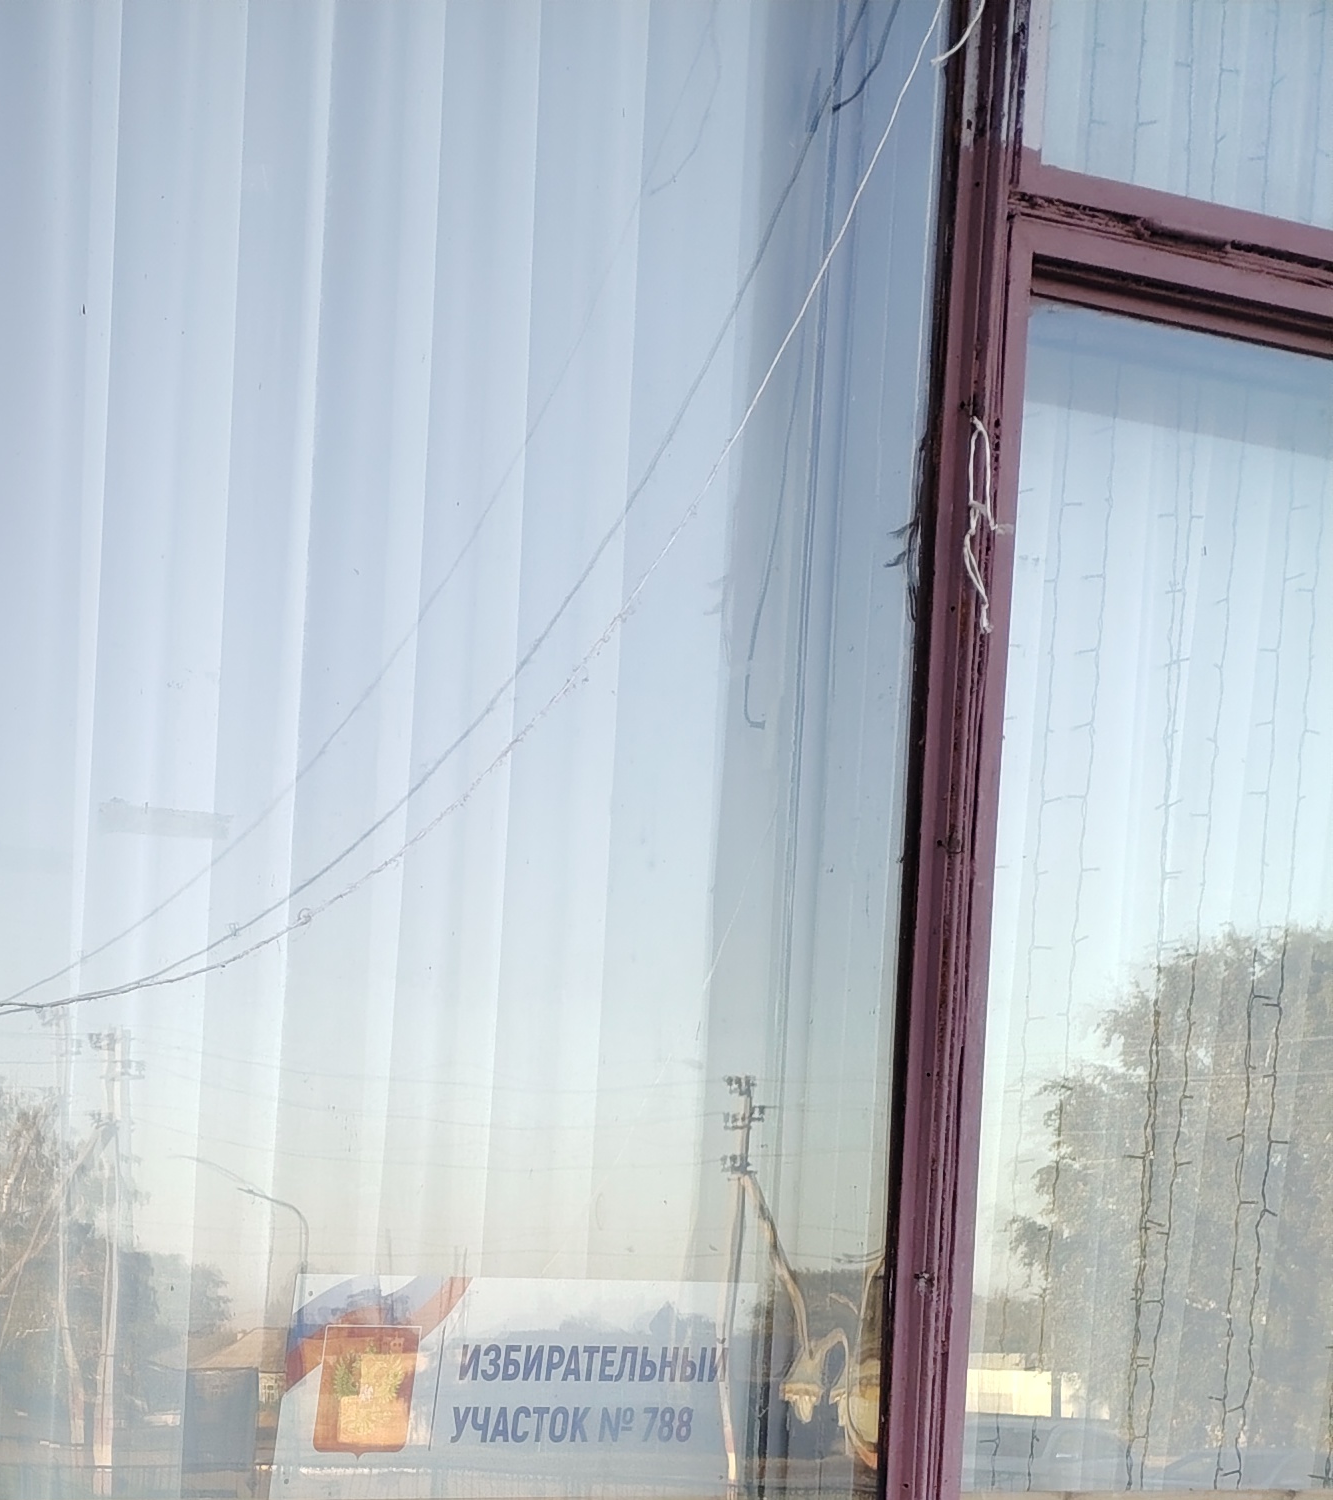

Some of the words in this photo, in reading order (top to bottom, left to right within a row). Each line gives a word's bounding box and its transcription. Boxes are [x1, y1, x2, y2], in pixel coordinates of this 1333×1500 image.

[458, 1337, 729, 1384] ИЗБИРАТЕЛЬНЫЙ
[450, 1405, 589, 1444] УЧАСТОК
[597, 1409, 634, 1443] №
[642, 1407, 694, 1443] 788
